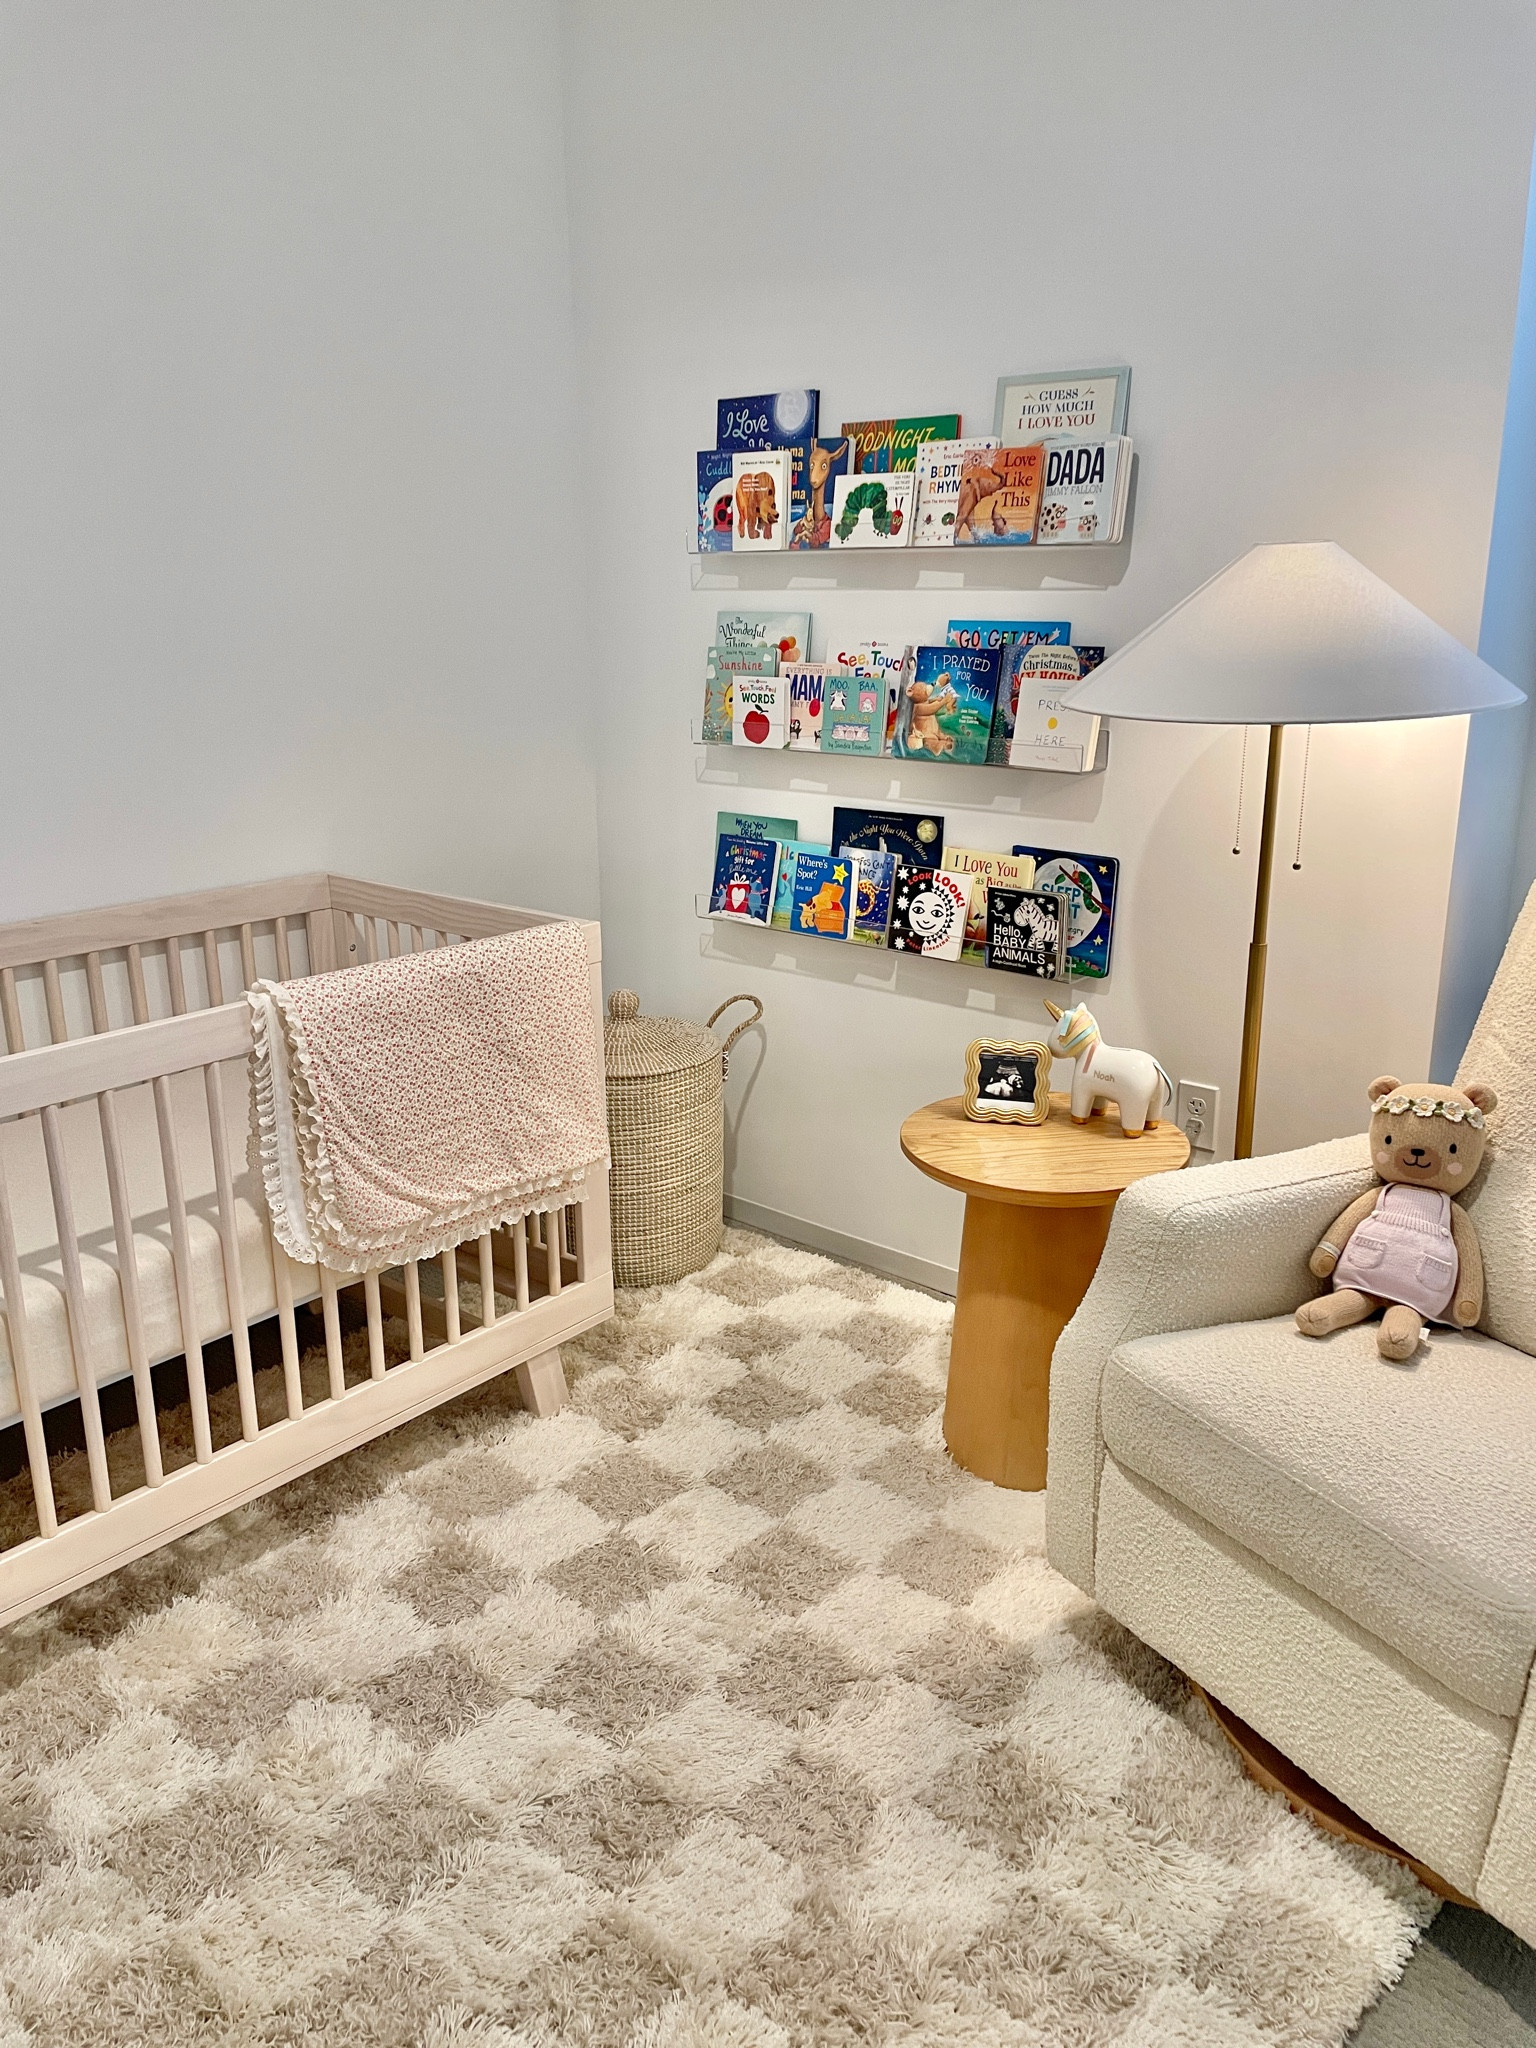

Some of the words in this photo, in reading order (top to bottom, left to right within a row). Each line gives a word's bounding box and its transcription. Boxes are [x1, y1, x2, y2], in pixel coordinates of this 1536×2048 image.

[1039, 388, 1079, 401] GUESS
[1022, 404, 1051, 415] HOW
[1054, 400, 1094, 413] MUCH
[722, 411, 734, 438] I
[732, 409, 769, 440] Love
[1018, 418, 1023, 430] I
[1027, 416, 1063, 429] LOVE
[1066, 414, 1096, 427] YOU
[848, 427, 936, 452] OODNIGHT
[893, 457, 917, 474] MO
[1004, 451, 1036, 468] Love
[1046, 446, 1105, 487] DADA
[705, 460, 732, 477] Cuddl
[931, 464, 964, 479] BEDTI
[929, 479, 961, 495] RHYM
[1002, 472, 1033, 488] Like
[1001, 491, 1031, 508] This
[1044, 486, 1069, 499] JIMMY
[1071, 484, 1103, 496] FALLON
[719, 622, 767, 640] Wonderful
[959, 629, 981, 649] GO
[987, 629, 1019, 648] GET
[718, 651, 763, 671] Sunshine
[871, 650, 904, 672] Touc
[932, 656, 938, 671] I
[942, 654, 991, 673] PRAYED
[1023, 658, 1073, 672] Christmas
[786, 666, 825, 675] EVERYTHING
[956, 671, 971, 681] FOR
[786, 673, 825, 702] MAM
[965, 683, 990, 702] YOU
[741, 692, 775, 705] WORDS
[1038, 699, 1067, 712] PRES
[1034, 734, 1067, 747] HERE
[753, 821, 768, 830] YOU
[740, 828, 763, 840] DREAM
[859, 824, 879, 837] Night
[879, 823, 896, 836] You
[895, 828, 914, 844] Were
[911, 840, 929, 861] Born
[730, 844, 768, 862] Christmas
[733, 855, 744, 864] gift
[745, 856, 755, 866] for
[798, 855, 829, 869] Where's
[954, 854, 960, 867] I
[962, 855, 993, 875] Love
[996, 861, 1018, 878] You
[797, 867, 818, 880] Spot?
[975, 877, 984, 885] as
[986, 876, 1004, 888] Big
[907, 872, 933, 886] LOOK
[934, 872, 966, 909] LOOK!
[1067, 927, 1085, 937] ngry
[905, 938, 921, 950] Peter
[993, 934, 1027, 949] BABY
[992, 946, 1046, 965] ANIMALS
[1093, 1069, 1115, 1083] Noah
